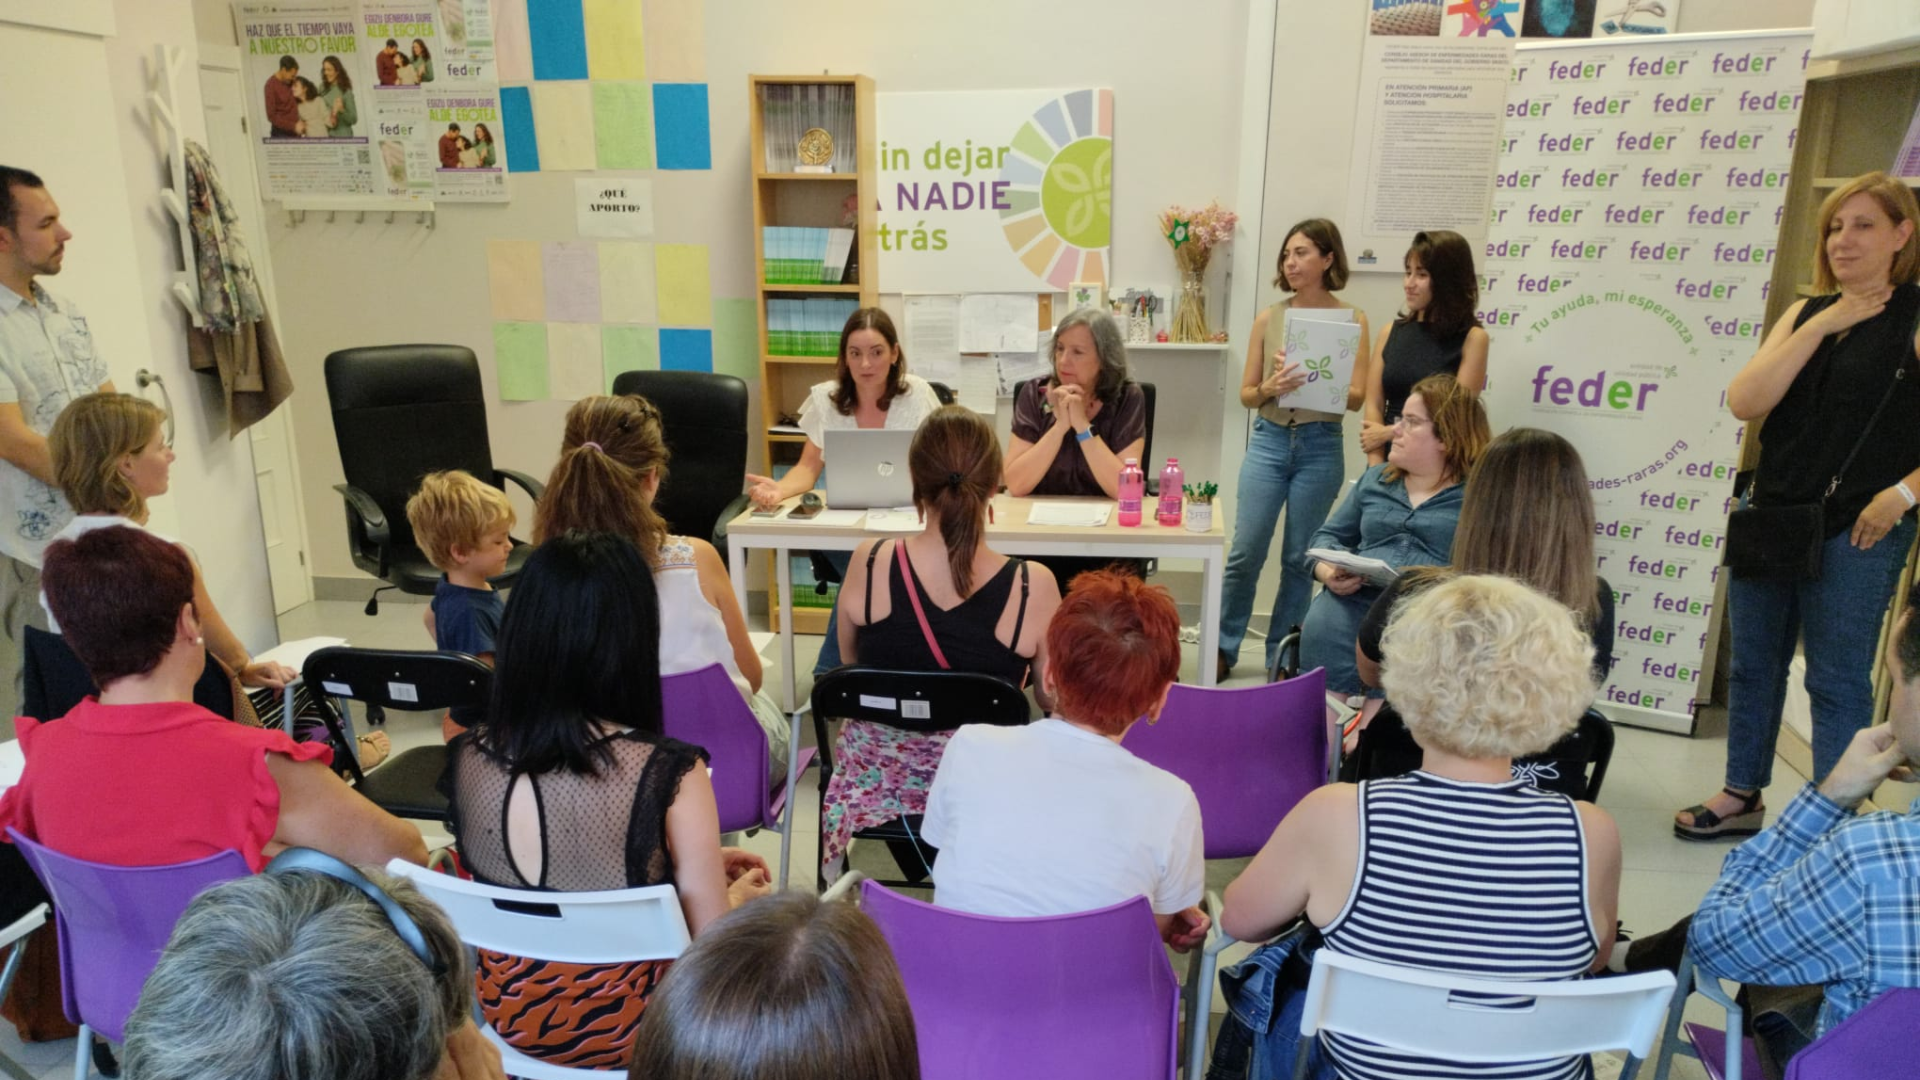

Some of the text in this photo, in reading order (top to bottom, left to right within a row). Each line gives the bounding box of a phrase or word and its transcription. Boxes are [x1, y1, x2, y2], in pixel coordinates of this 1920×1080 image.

[246, 22, 355, 37] HAZ QUE EL TIEMPO VAYA
[249, 36, 356, 55] A NUESTRO FAVOR
[447, 64, 482, 76] feder
[1549, 60, 1606, 80] feder
[1628, 56, 1689, 76] feder
[1712, 53, 1777, 73] feder
[1506, 99, 1552, 117] eder
[1573, 96, 1631, 115] feder
[1653, 93, 1715, 113] feder
[1739, 90, 1803, 111] feder
[380, 123, 414, 136] feder
[1700, 129, 1763, 150] feder
[1538, 133, 1595, 152] feder
[1617, 131, 1677, 150] feder
[881, 139, 1011, 177] in dejar
[1496, 170, 1541, 188] eder
[1562, 168, 1619, 187] feder
[1641, 167, 1703, 187] feder
[1726, 167, 1789, 188] feder
[897, 181, 1011, 211] NADIE
[589, 203, 641, 213] APORTO?
[1528, 204, 1583, 223] feder
[1605, 204, 1664, 223] feder
[1688, 205, 1751, 225] feder
[878, 220, 948, 251] trás
[1486, 240, 1530, 258] eder
[1551, 239, 1608, 259] feder
[1630, 241, 1690, 261] feder
[1714, 242, 1776, 263] feder
[1675, 278, 1738, 299] feder
[1476, 308, 1520, 325] eder
[1530, 290, 1694, 344] Tu ayuda, mi esperanza
[1532, 365, 1659, 411] feder
[1589, 439, 1688, 490] ades-raras.org
[1677, 461, 1737, 480] eder
[1640, 491, 1700, 511] feder
[1595, 520, 1642, 539] eder
[1665, 525, 1725, 549] feder
[1629, 555, 1688, 579] feder
[1653, 592, 1712, 616] feder
[1618, 621, 1676, 645] feder
[1642, 658, 1700, 682] feder
[1607, 685, 1664, 709] feder
